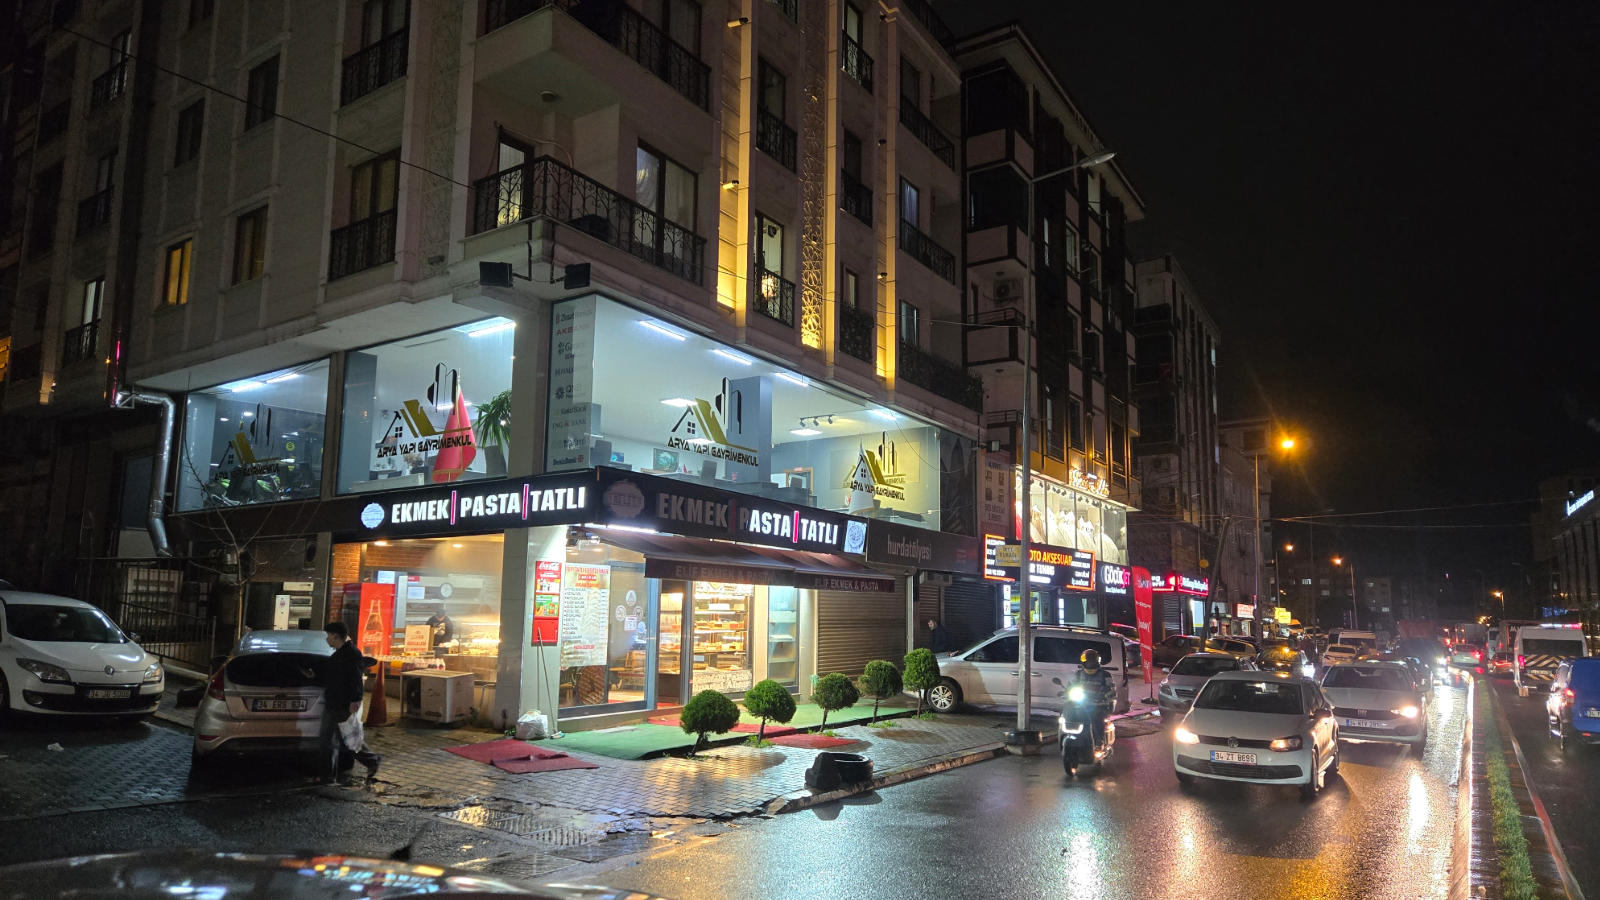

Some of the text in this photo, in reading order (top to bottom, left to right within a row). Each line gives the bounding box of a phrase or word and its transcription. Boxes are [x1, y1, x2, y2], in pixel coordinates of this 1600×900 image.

[556, 322, 591, 336] AKBANK
[564, 340, 587, 352] Garanti
[377, 435, 472, 458] ARYA YAPI GAYRİMENKUL
[667, 436, 759, 467] ARYA YAPI GAYRİMENKUL
[849, 480, 864, 491] ARYA
[391, 503, 449, 524] EKMEK
[460, 492, 521, 518] PASTA
[530, 486, 586, 512] TATLI
[658, 492, 839, 545] EKMEK PASTA TATLI
[887, 534, 932, 563] hurdatölyesi
[1042, 551, 1073, 566] AKSESUAR
[675, 564, 697, 578] ELİF
[700, 566, 735, 579] EKMEK
[746, 570, 774, 583] PASTA
[814, 576, 829, 588] ELİF
[830, 578, 853, 590] EKMEK
[860, 580, 879, 591] PASTA
[90, 690, 99, 698] 34
[257, 701, 305, 709] 34 ERS 634
[1215, 752, 1224, 760] 34
[1226, 753, 1235, 761] ZT
